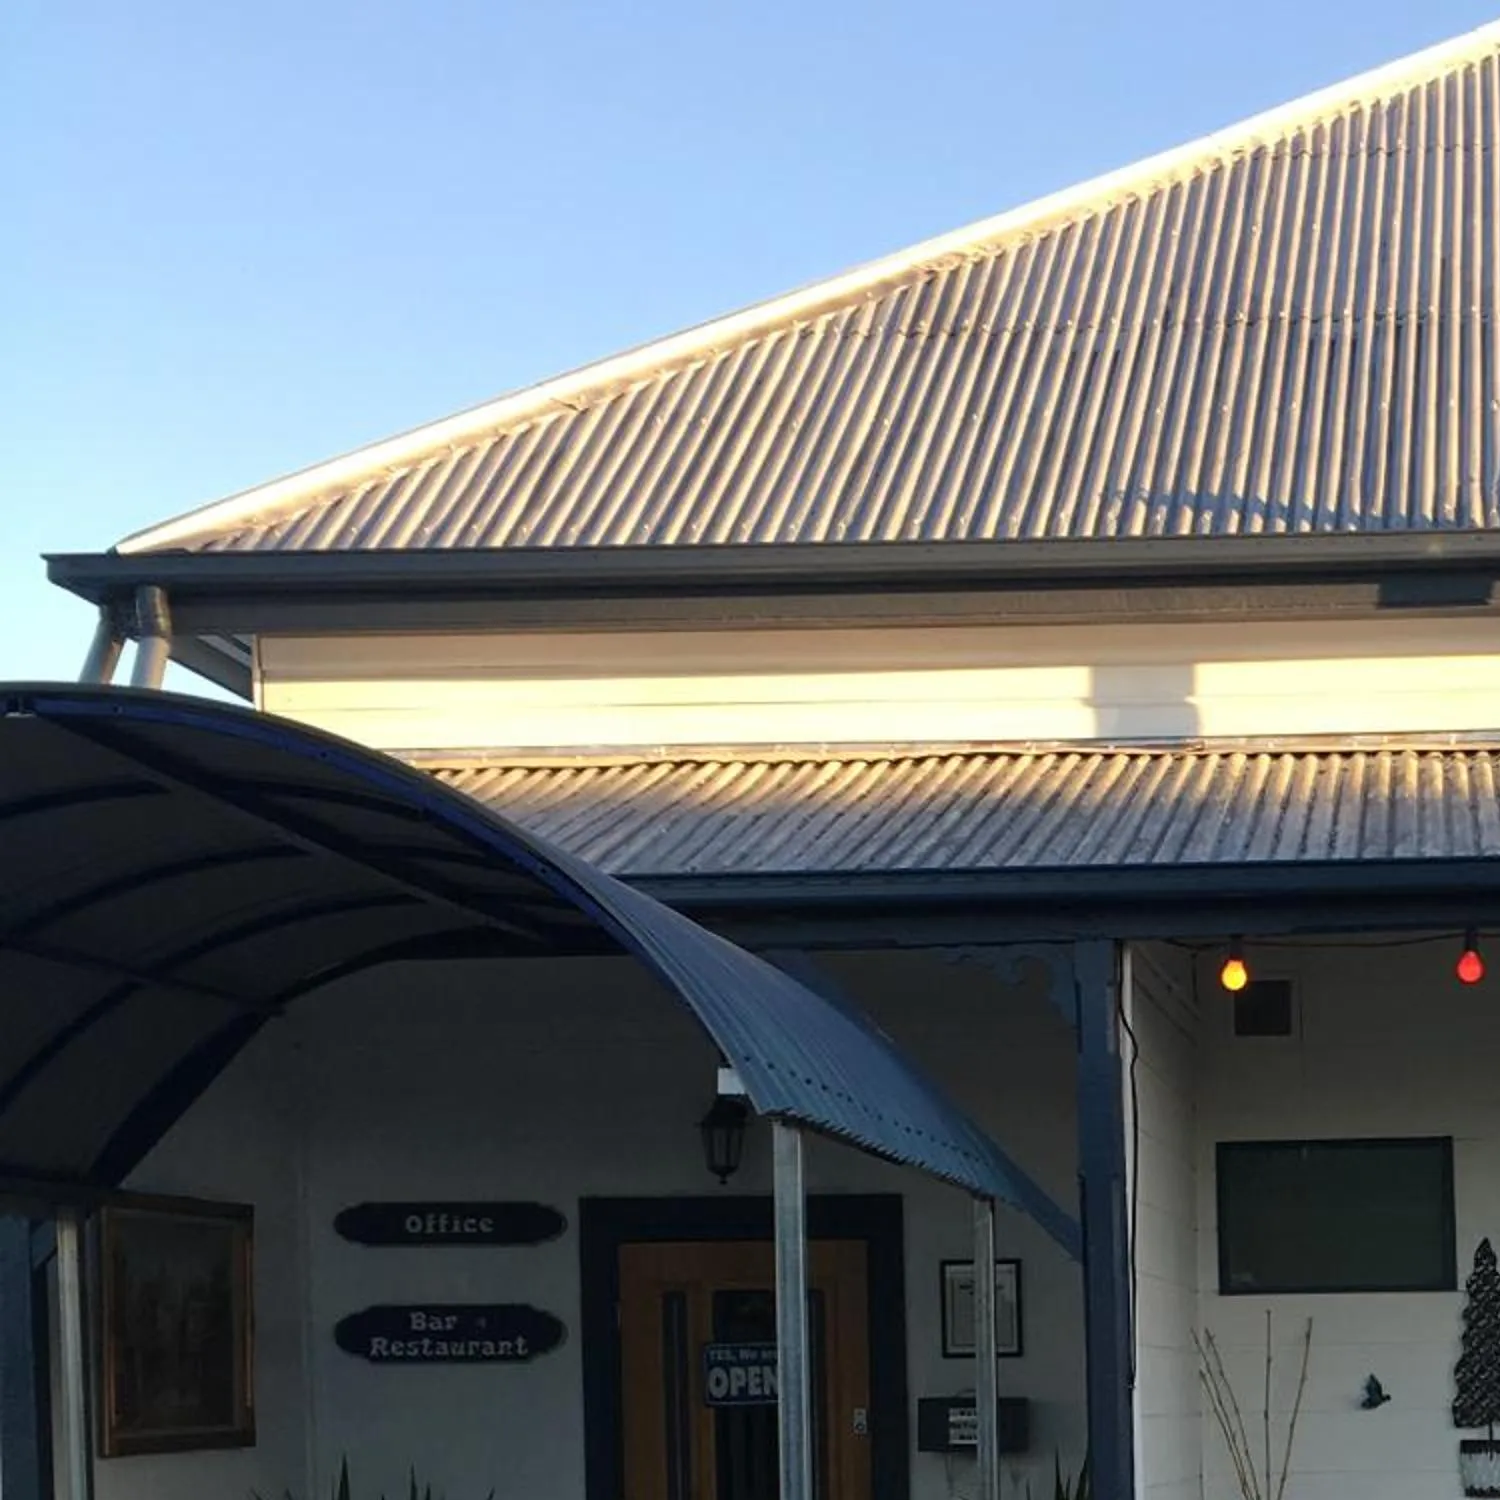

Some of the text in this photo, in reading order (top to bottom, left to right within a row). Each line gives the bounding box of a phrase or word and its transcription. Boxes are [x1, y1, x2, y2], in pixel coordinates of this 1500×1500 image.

[405, 1213, 495, 1234] Office
[409, 1311, 458, 1331] Bar
[370, 1335, 529, 1357] Restaurant
[709, 1365, 779, 1399] OPEN
